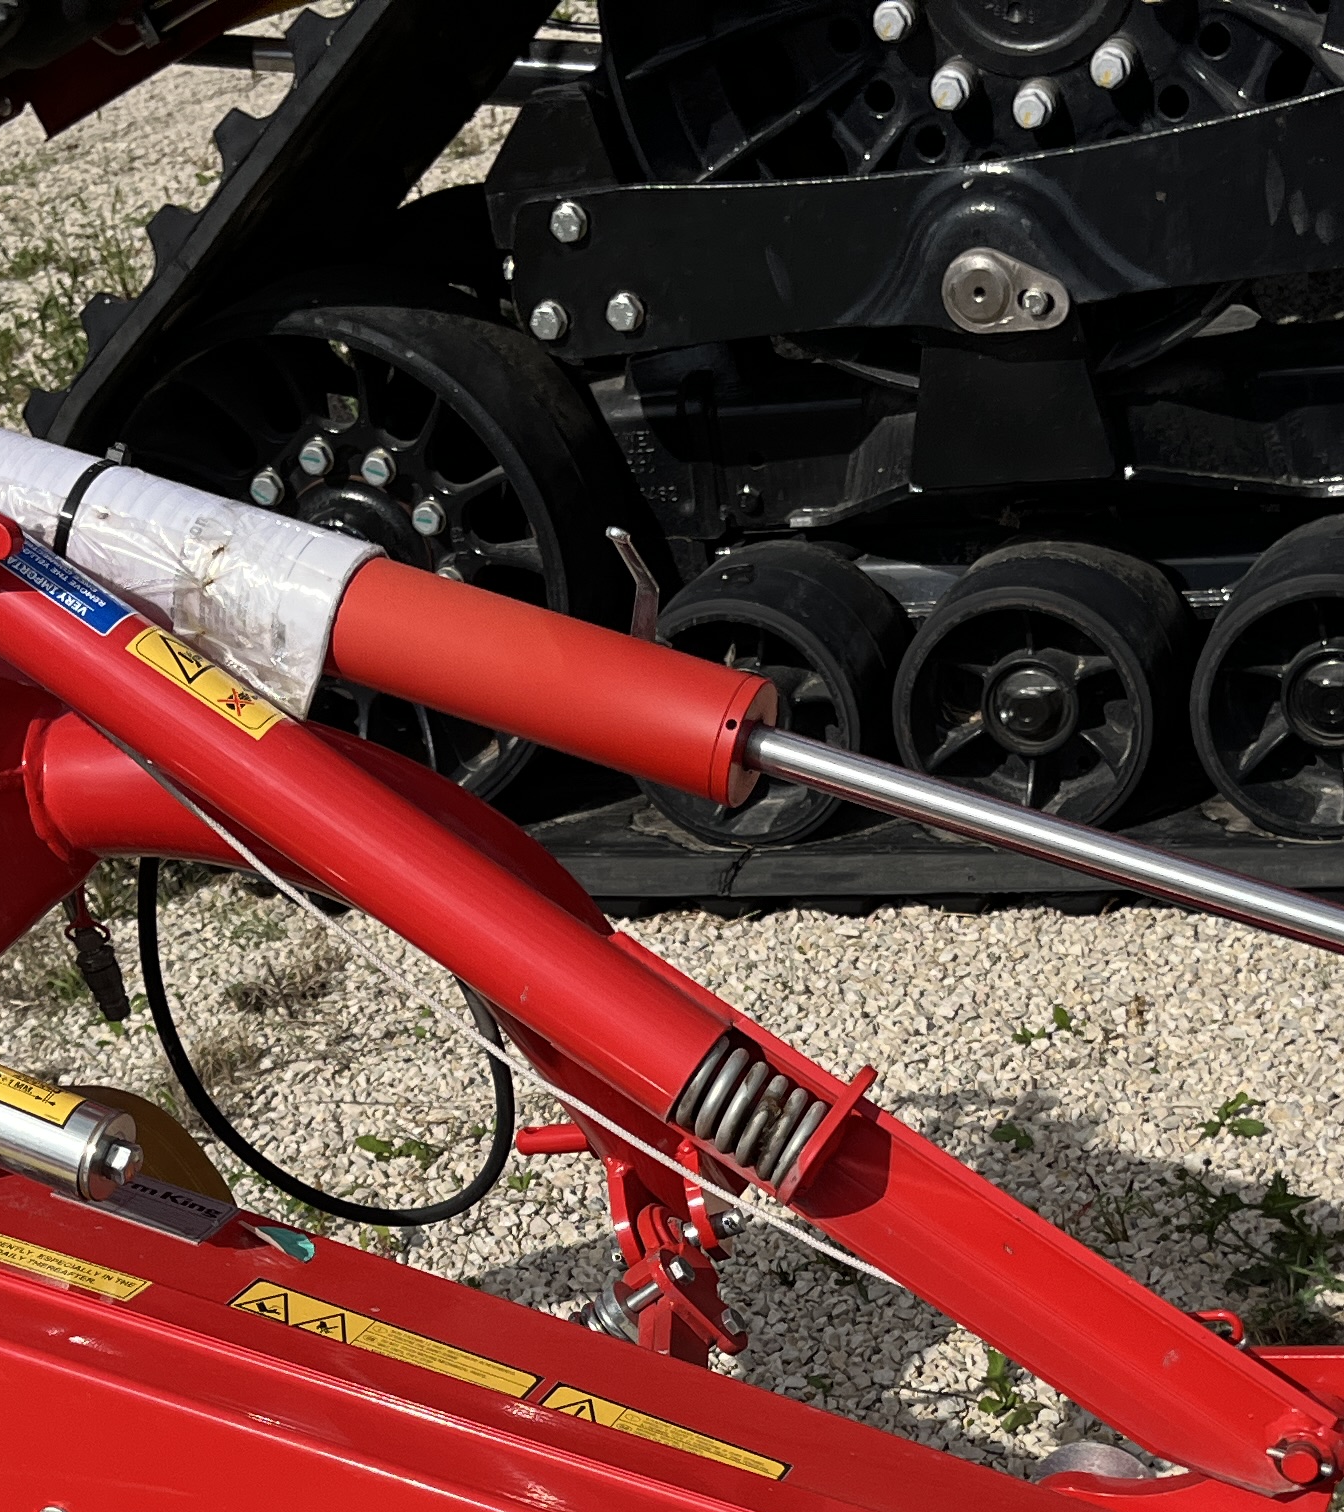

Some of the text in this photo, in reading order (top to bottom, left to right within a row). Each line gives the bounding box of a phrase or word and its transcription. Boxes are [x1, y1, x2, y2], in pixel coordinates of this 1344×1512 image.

[6, 556, 87, 617] VERY IMPORTA
[22, 547, 106, 607] REMOVE THE YELLO
[159, 1191, 223, 1219] King
[36, 1253, 101, 1277] ESPECIALLY
[101, 1273, 115, 1282] IN
[115, 1276, 137, 1289] THE
